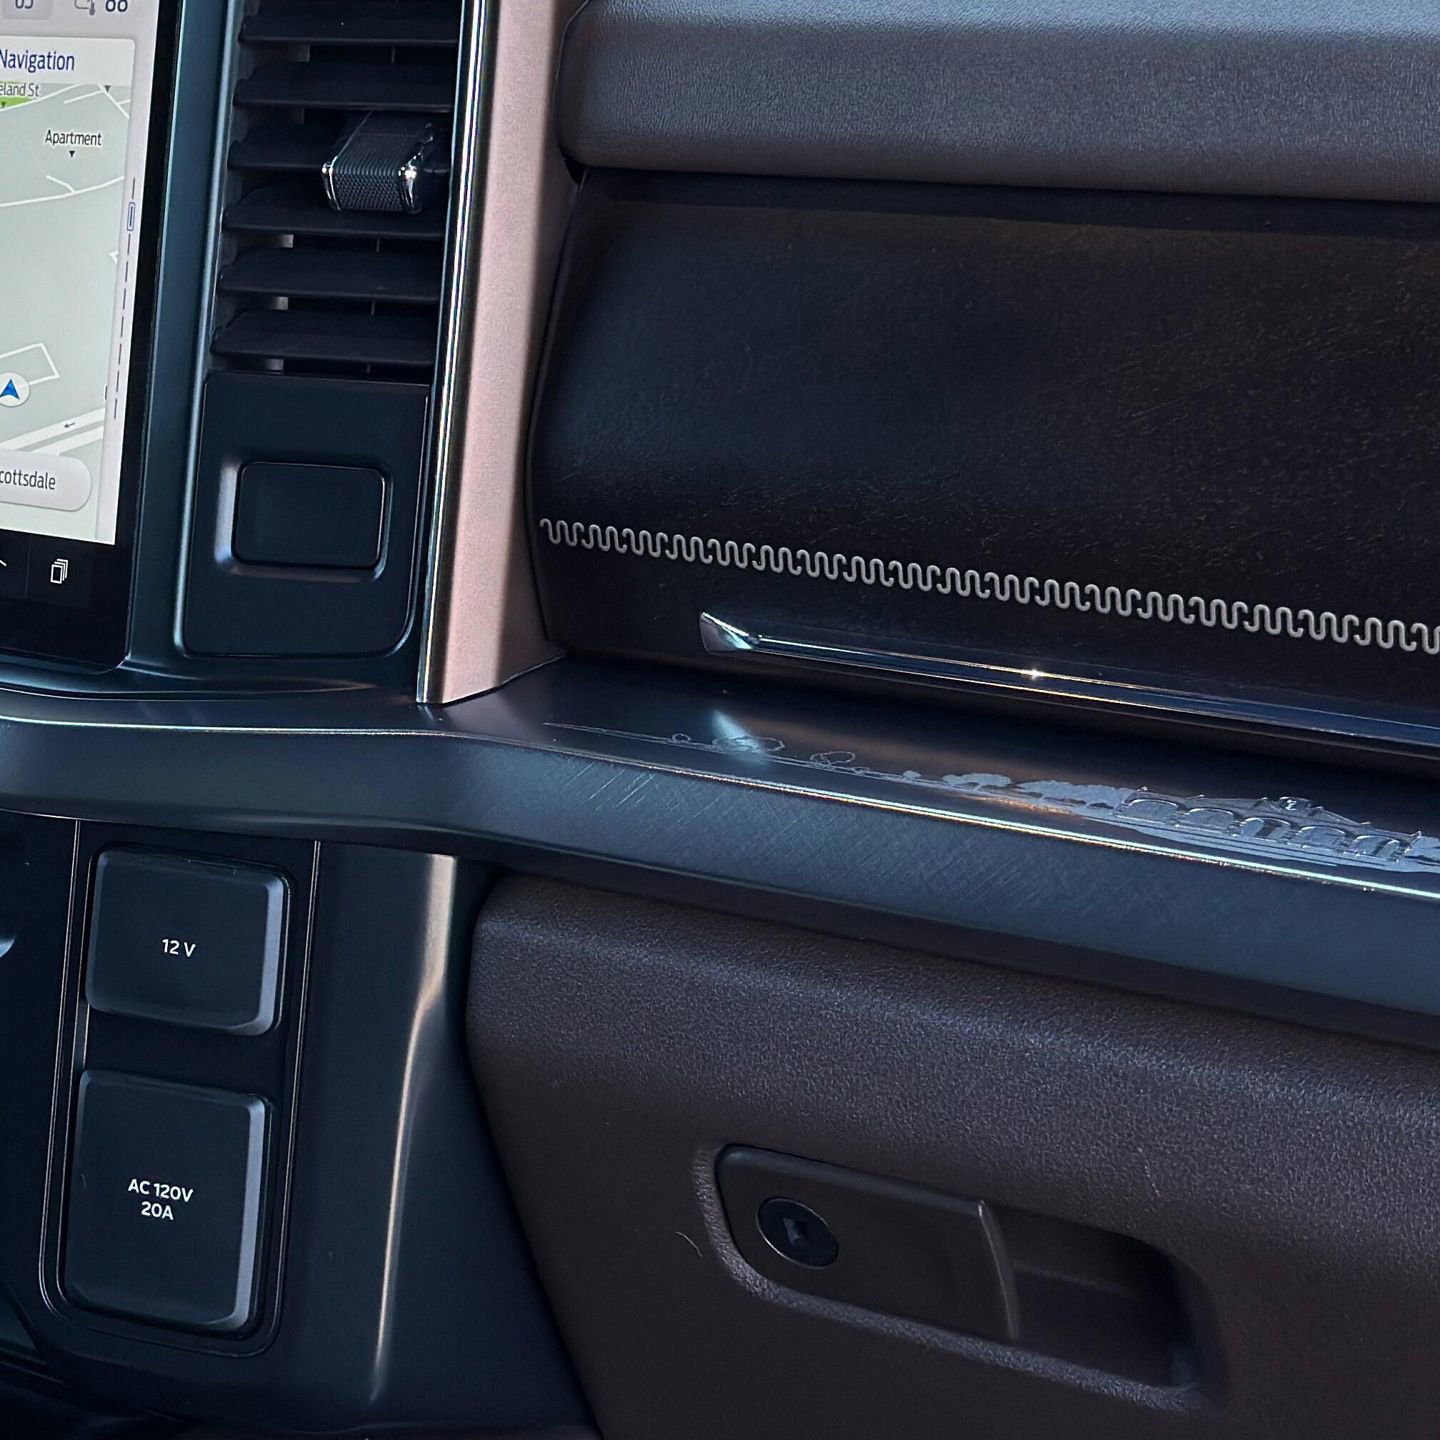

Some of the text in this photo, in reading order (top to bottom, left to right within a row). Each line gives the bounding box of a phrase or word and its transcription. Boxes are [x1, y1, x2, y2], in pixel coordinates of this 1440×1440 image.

[27, 83, 39, 97] St
[44, 129, 102, 148] Apartment
[162, 937, 197, 958] 12 V
[128, 1177, 195, 1205] AC 120V
[141, 1201, 175, 1222] 20A
